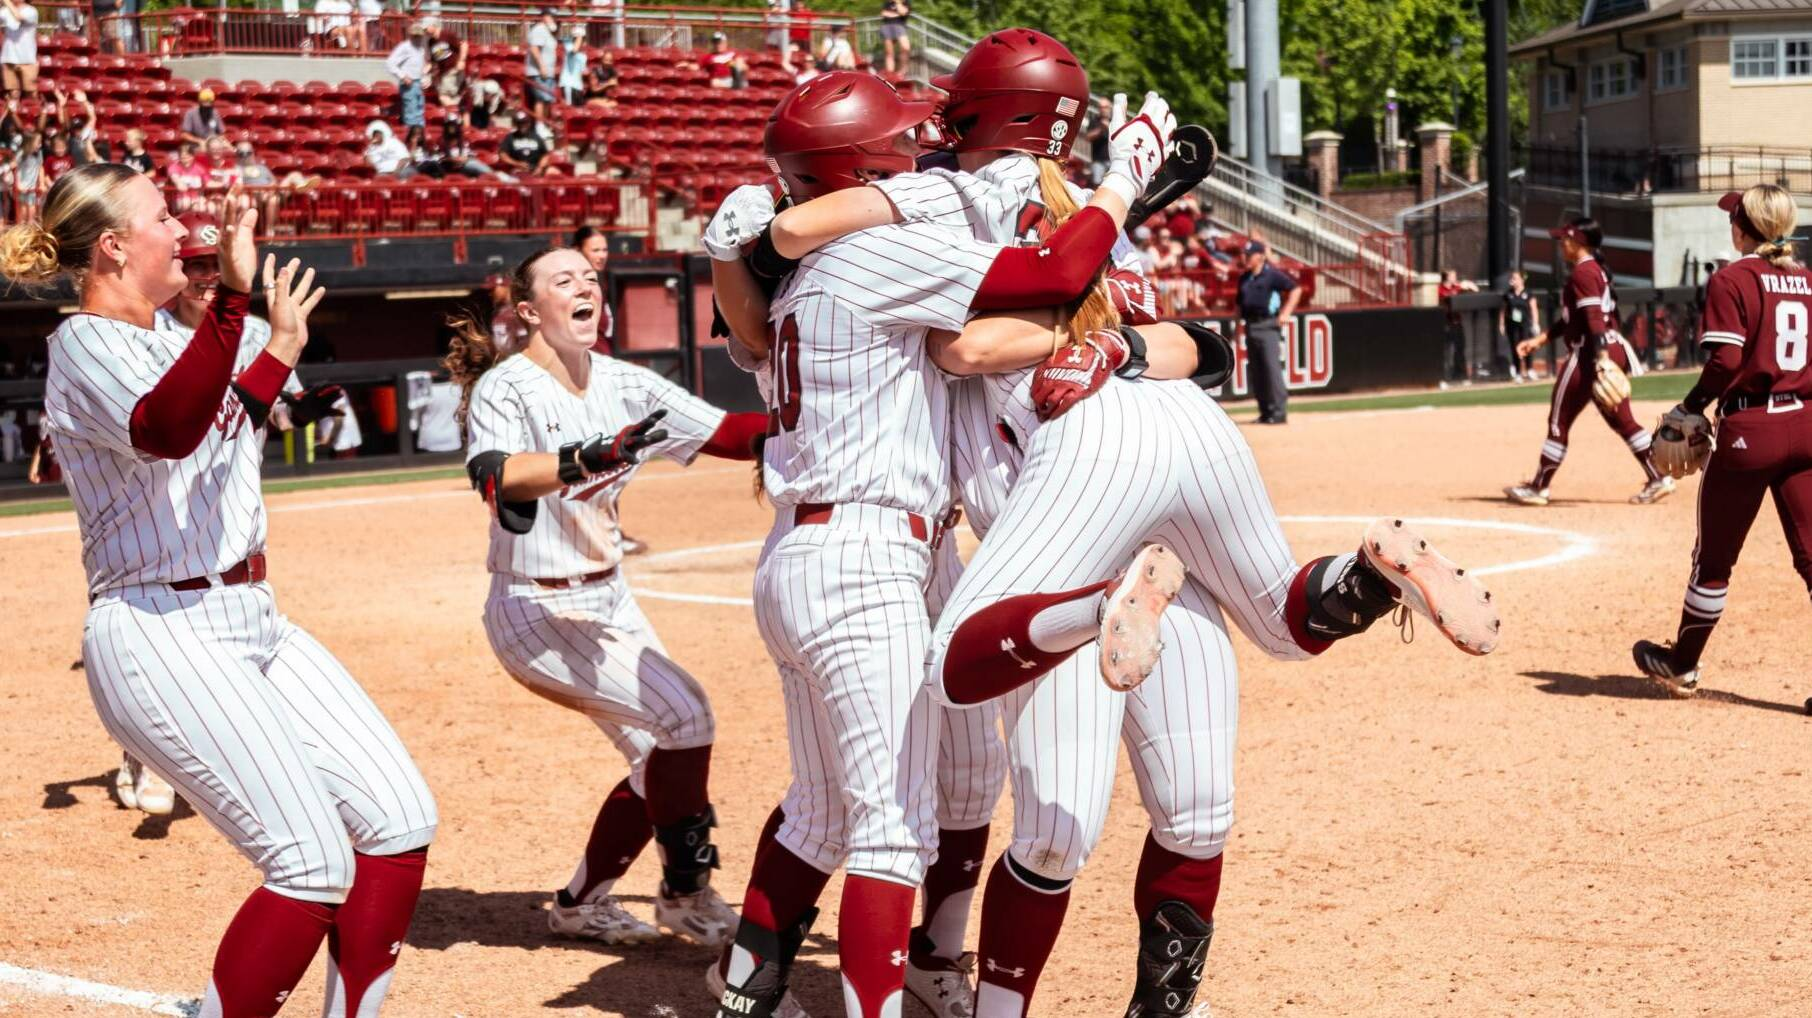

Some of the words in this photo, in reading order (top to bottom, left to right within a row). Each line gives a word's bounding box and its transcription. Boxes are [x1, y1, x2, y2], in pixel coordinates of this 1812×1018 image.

[1046, 140, 1063, 156] 33
[1760, 273, 1812, 295] VRAZEL
[1229, 314, 1333, 395] FLD
[1775, 300, 1808, 371] 8
